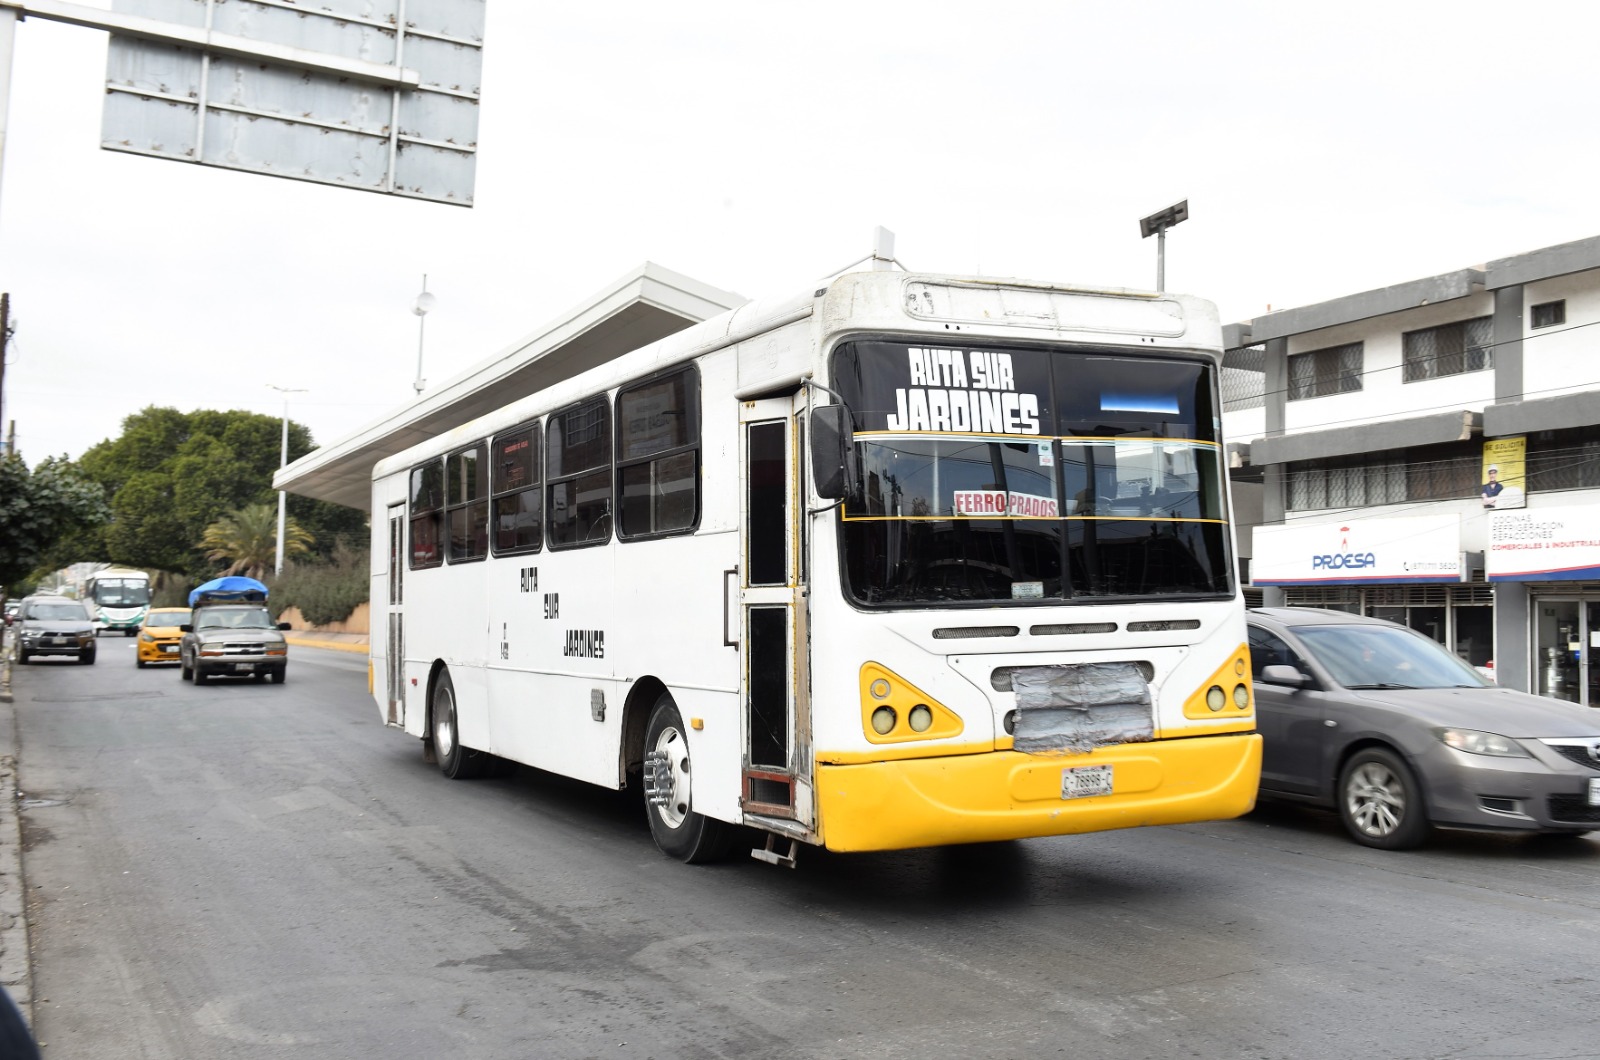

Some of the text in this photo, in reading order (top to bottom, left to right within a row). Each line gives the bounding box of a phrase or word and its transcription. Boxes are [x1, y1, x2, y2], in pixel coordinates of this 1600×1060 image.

[908, 347, 1014, 391] RUTA SUR
[886, 388, 1039, 434] JARDINES
[955, 492, 1006, 513] FERRO
[1009, 494, 1056, 517] PRADOS
[1493, 514, 1532, 525] COCINAS
[1491, 542, 1543, 551] COMERCIALES
[1492, 530, 1553, 541] REFACCIONES
[1312, 552, 1376, 570] PROESA
[521, 567, 538, 593] RUTA
[544, 593, 559, 619] SUR
[563, 629, 604, 659] JARDINES
